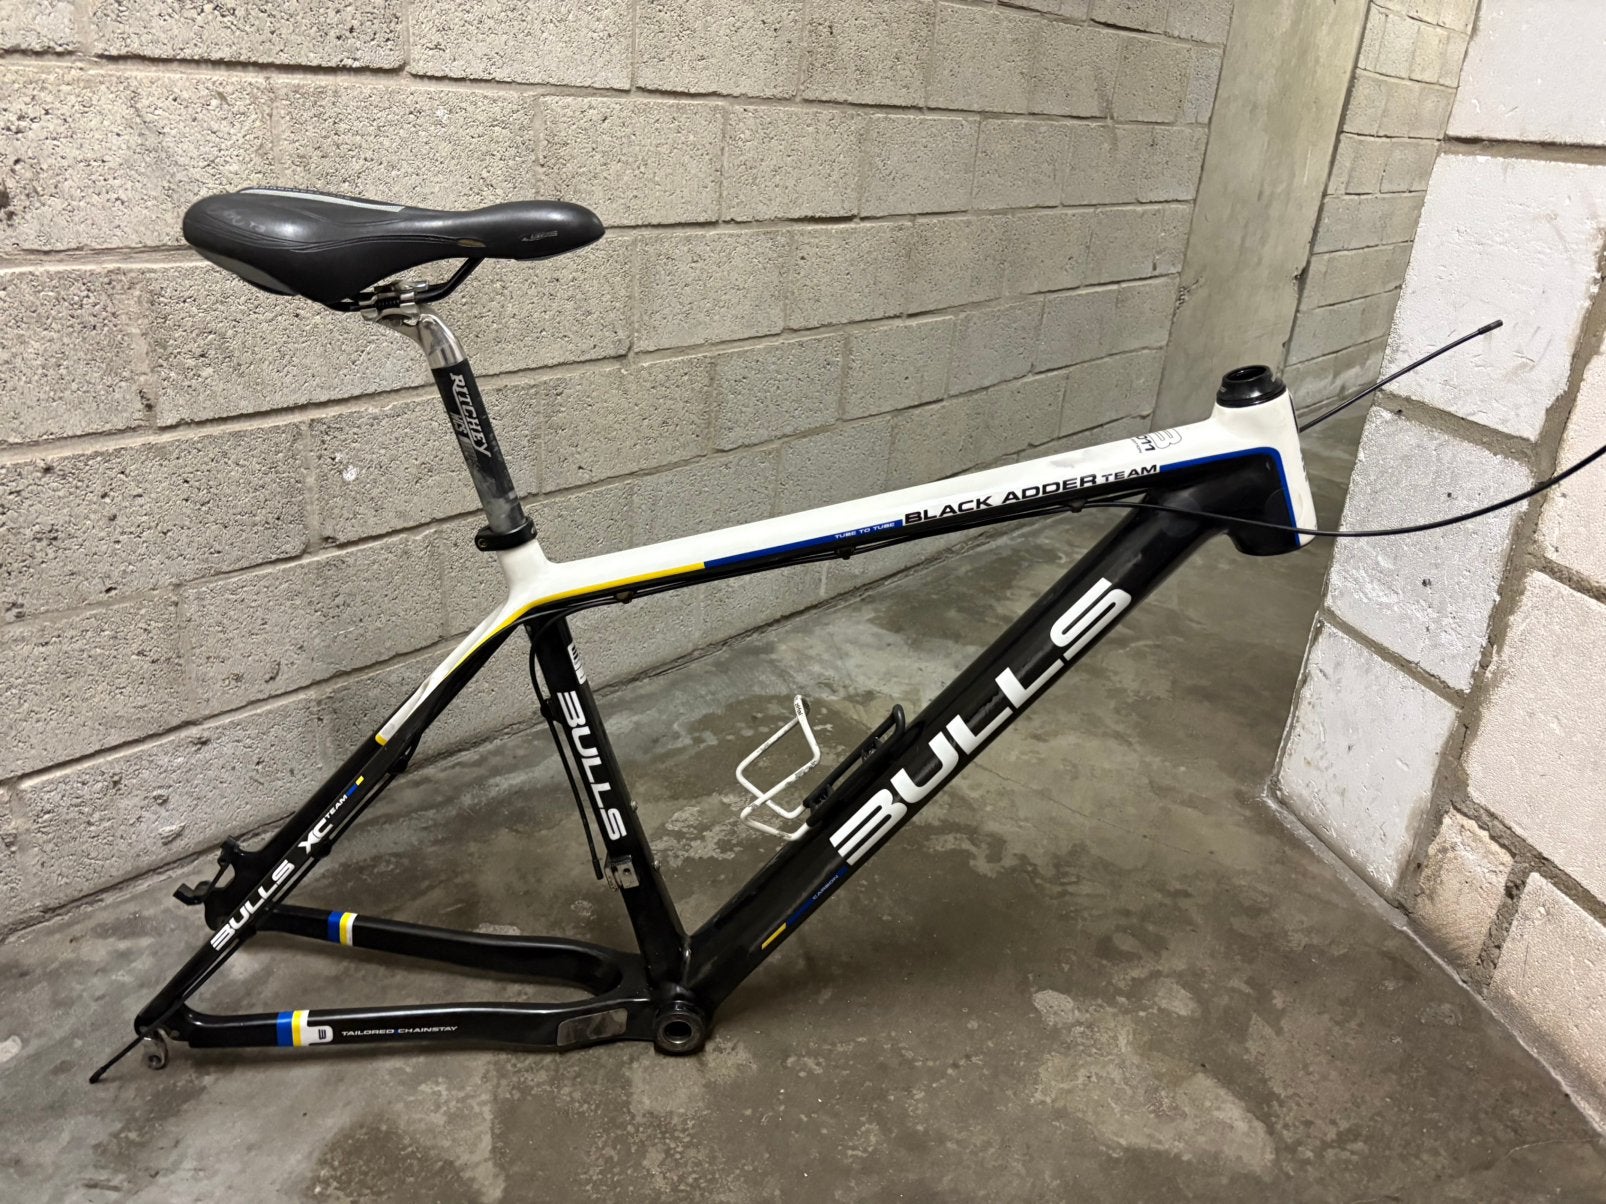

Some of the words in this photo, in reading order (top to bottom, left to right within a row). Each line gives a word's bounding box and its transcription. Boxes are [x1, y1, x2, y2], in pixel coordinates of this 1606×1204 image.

[450, 373, 492, 457] RITCHEY
[835, 530, 856, 539] TUBE
[873, 522, 895, 530] TUBE
[904, 496, 992, 525] BLACK
[1000, 473, 1097, 504] ADDER
[1101, 464, 1158, 483] TEAM
[829, 577, 1132, 866] BULLS
[557, 690, 628, 841] BULLS
[210, 859, 295, 951] BULLS
[297, 817, 333, 855] XC
[325, 794, 348, 818] TEAM
[812, 874, 839, 900] CARBON
[341, 1028, 395, 1037] TAILORED
[397, 1025, 458, 1034] CHAINSTAY
